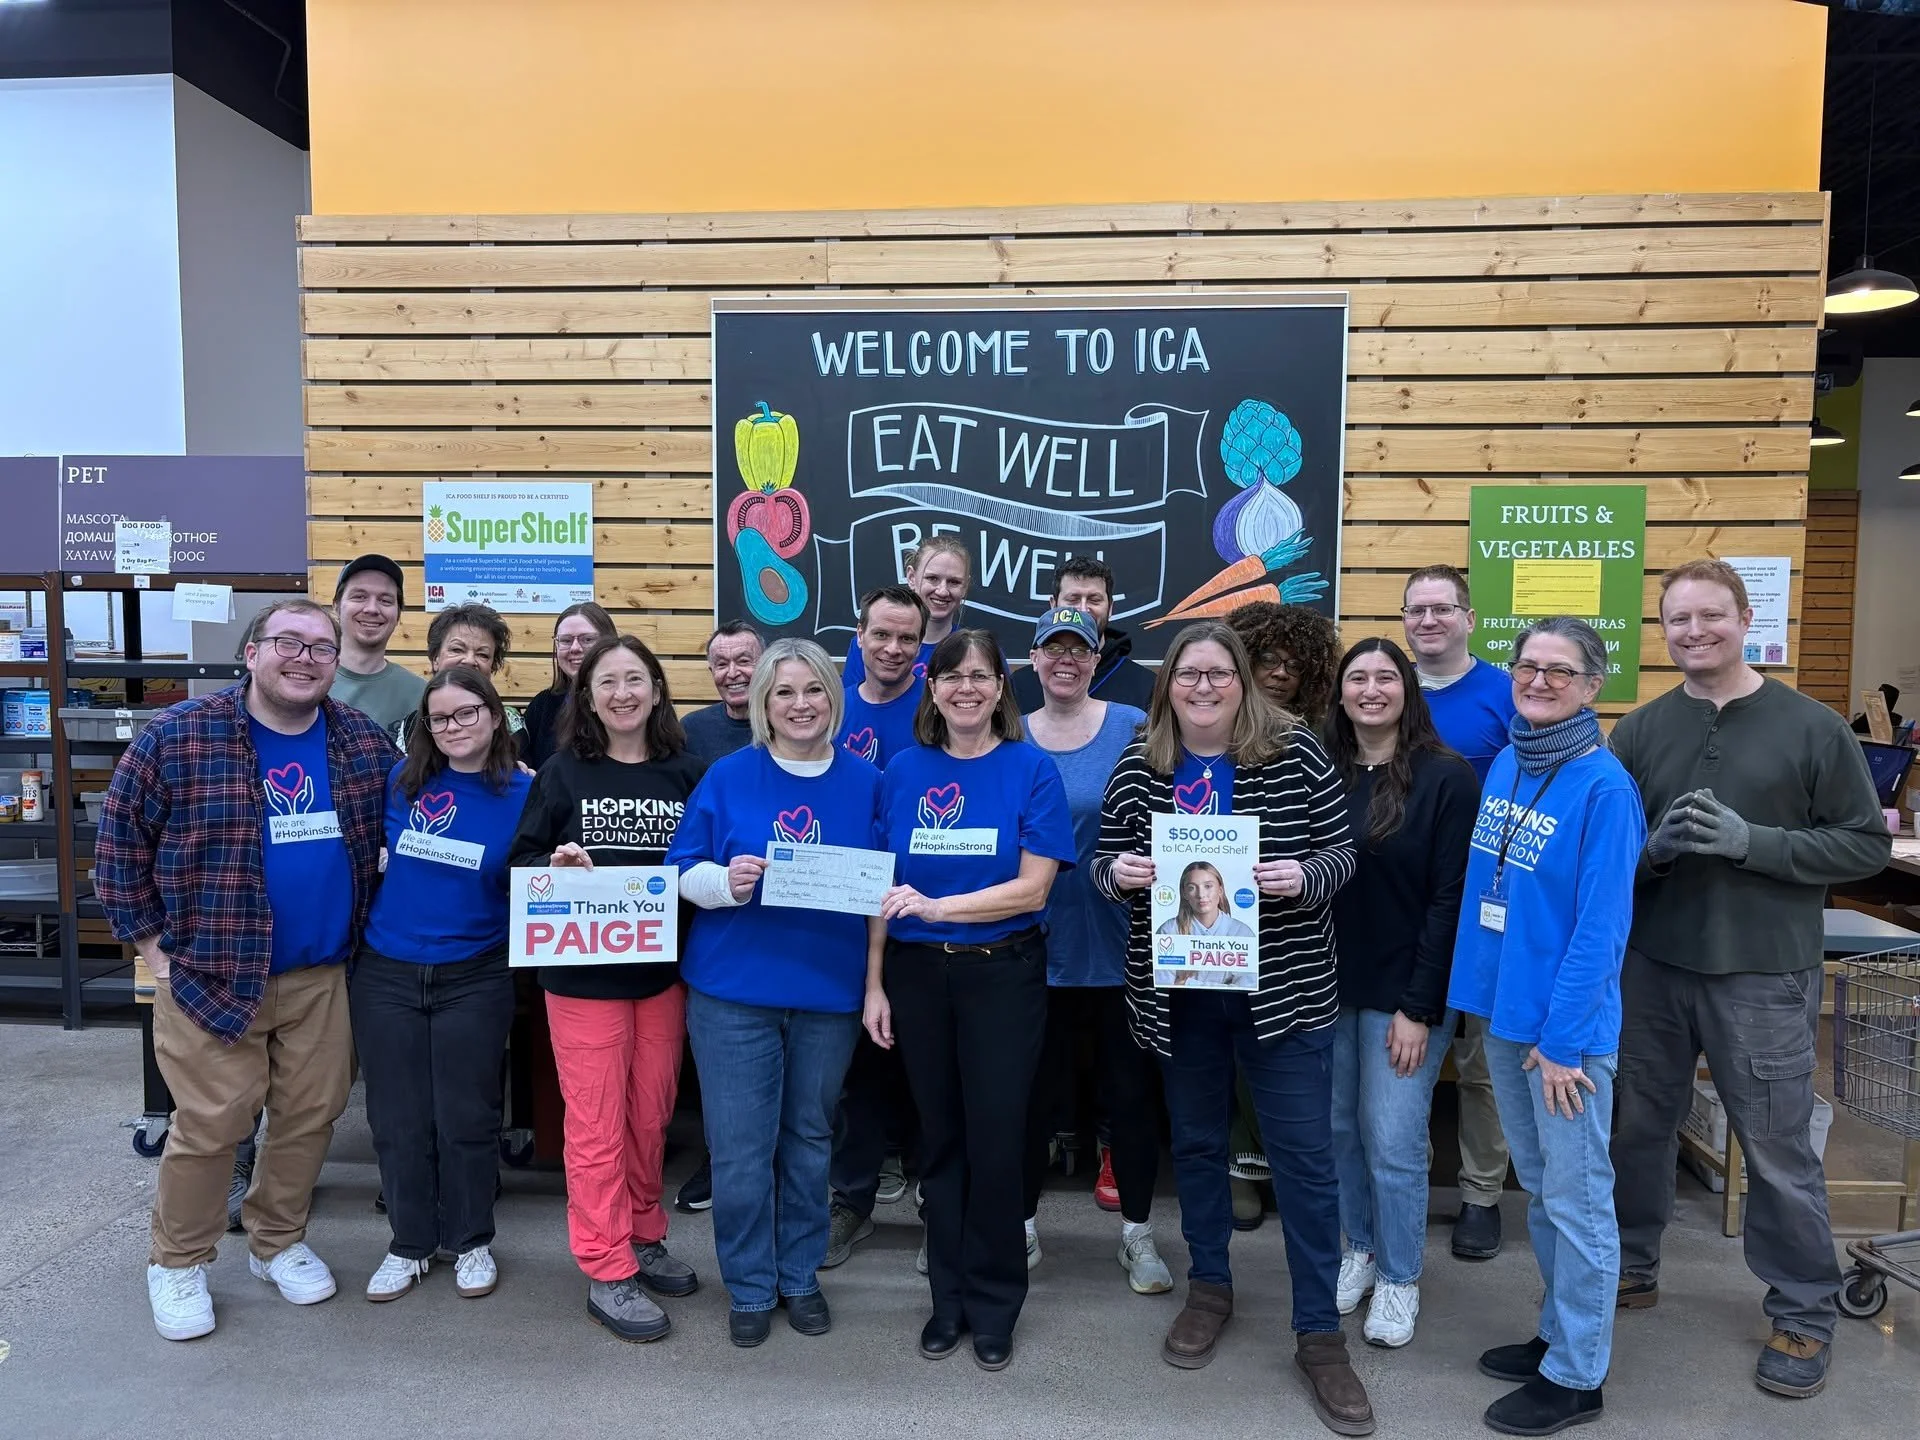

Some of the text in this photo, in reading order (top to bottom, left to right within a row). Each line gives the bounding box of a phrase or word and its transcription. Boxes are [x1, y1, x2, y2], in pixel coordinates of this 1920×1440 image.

[811, 326, 1211, 377] WELCOME TO ICA
[873, 413, 1135, 498] EAT WELL
[67, 466, 108, 484] PET
[66, 514, 126, 524] MASCOTA
[1501, 505, 1614, 524] FRUITS &
[65, 531, 114, 544] ДОМАШ
[446, 511, 588, 550] SuperShelf
[1478, 540, 1635, 559] VEGETABLES
[892, 523, 1126, 600] B WE
[427, 585, 445, 597] ICA
[1052, 609, 1085, 626] ICA
[581, 797, 685, 817] HOPKINS
[273, 820, 288, 828] We
[582, 816, 681, 830] EDUCATIO
[403, 832, 431, 845] We are
[914, 832, 929, 841] We
[1168, 827, 1238, 844] $50,000
[399, 842, 478, 867] #HopkinsStrong
[913, 842, 993, 852] #HopkinsStrong
[1162, 844, 1249, 855] to ICA Food Shelf
[628, 883, 641, 891] ICA
[1158, 891, 1173, 901] ICA
[574, 900, 665, 914] Thank You
[525, 919, 663, 956] PAIGE
[1190, 939, 1249, 951] Thank You
[1189, 950, 1249, 967] PAIGE
